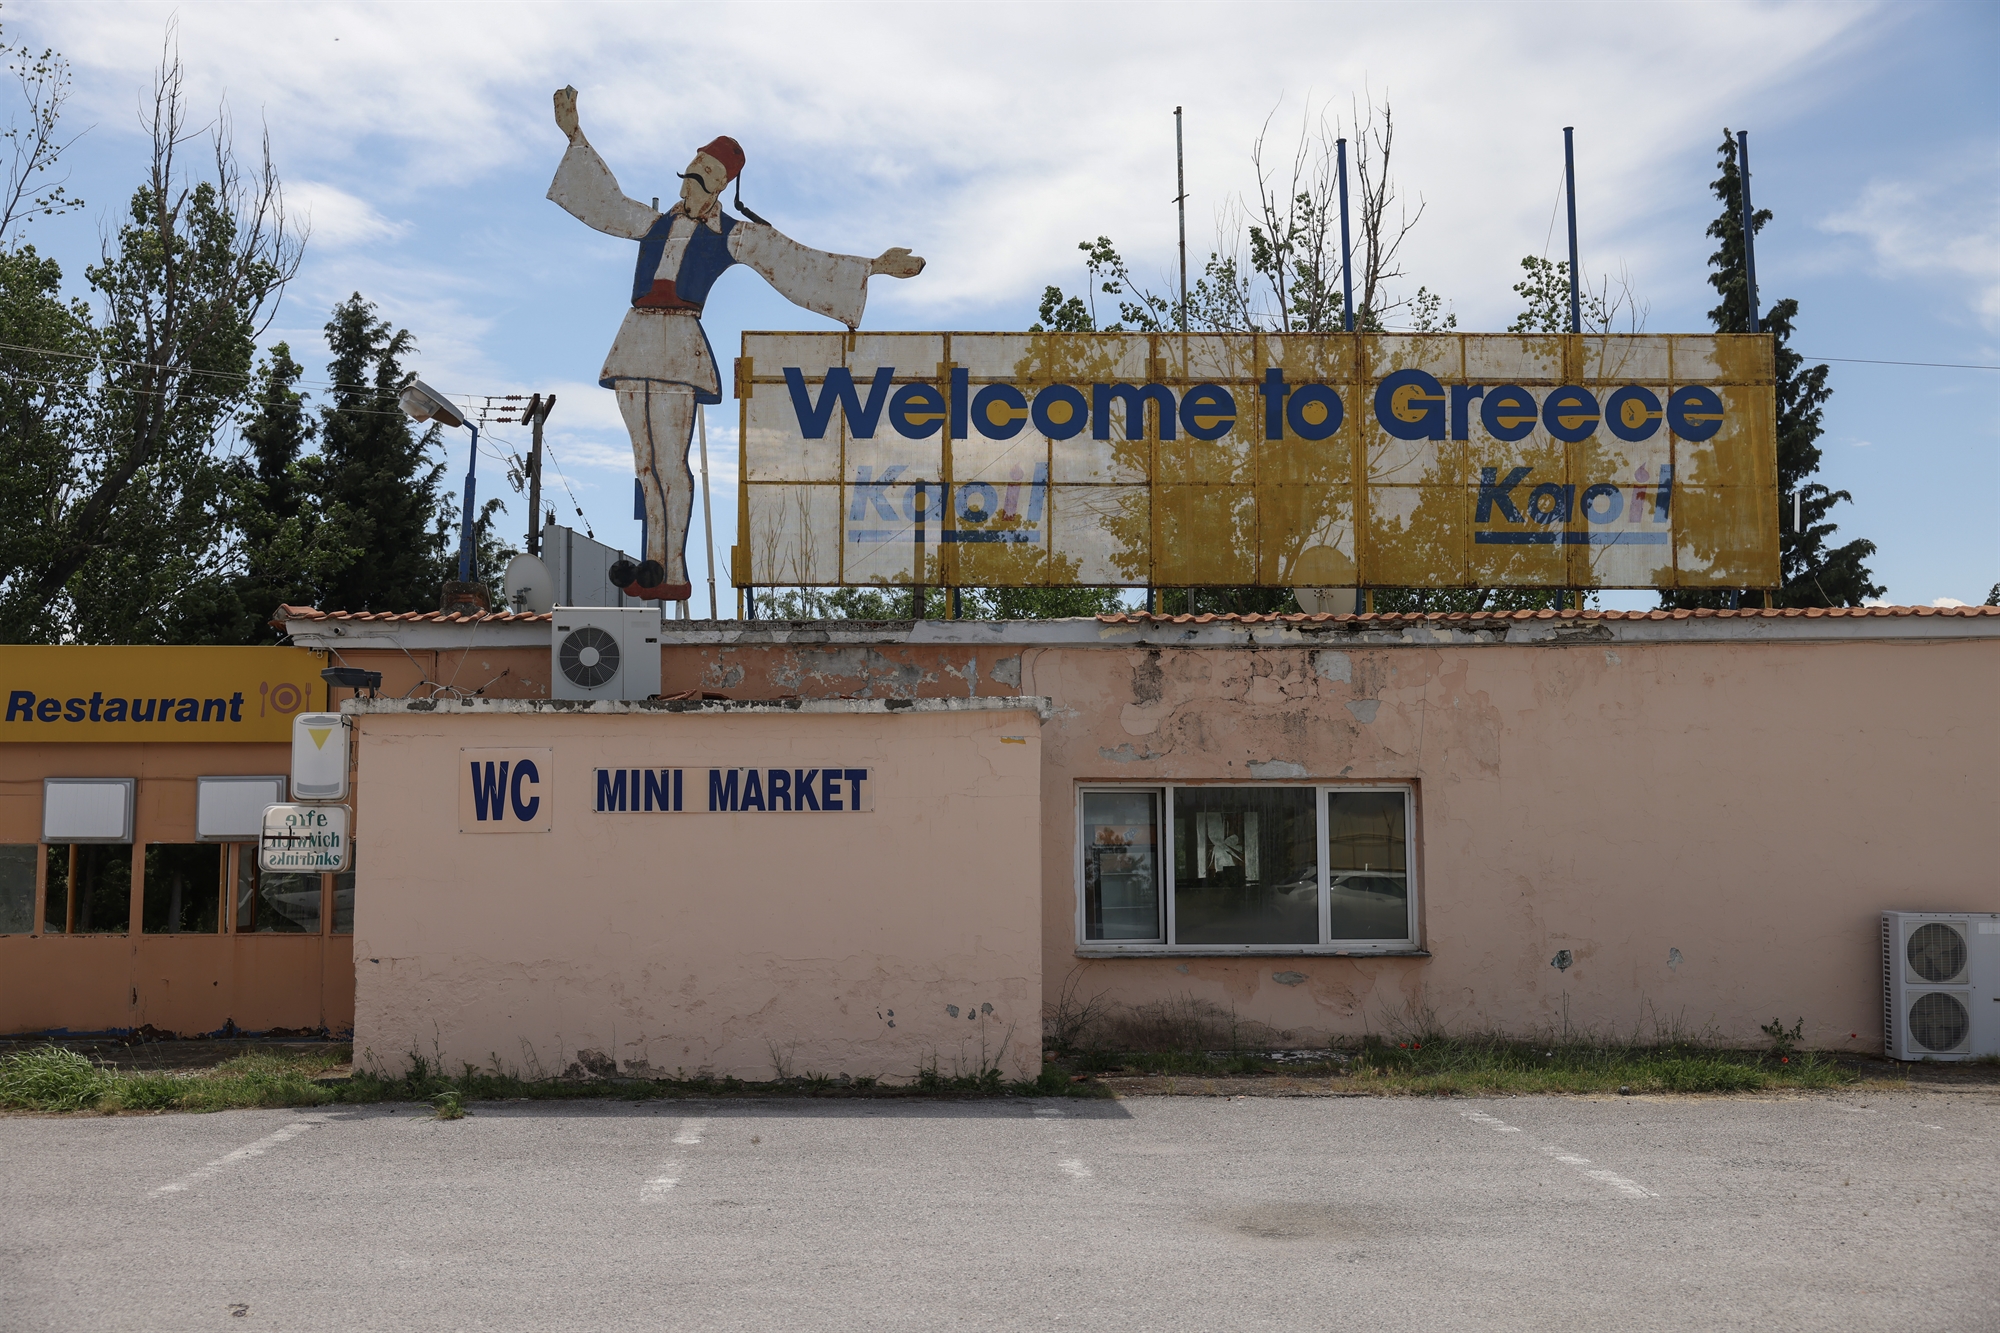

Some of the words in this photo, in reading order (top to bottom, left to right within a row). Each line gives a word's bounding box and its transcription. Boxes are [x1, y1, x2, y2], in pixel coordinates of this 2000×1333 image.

[782, 366, 1237, 441] Welcome
[1259, 367, 1344, 441] to
[1374, 368, 1724, 442] Greece
[849, 461, 1048, 523] Kaoil
[1474, 463, 1675, 525] Kaoil
[5, 690, 244, 723] Restaurant
[470, 759, 540, 822] WC
[597, 769, 683, 812] MINI
[709, 769, 868, 811] MARKET
